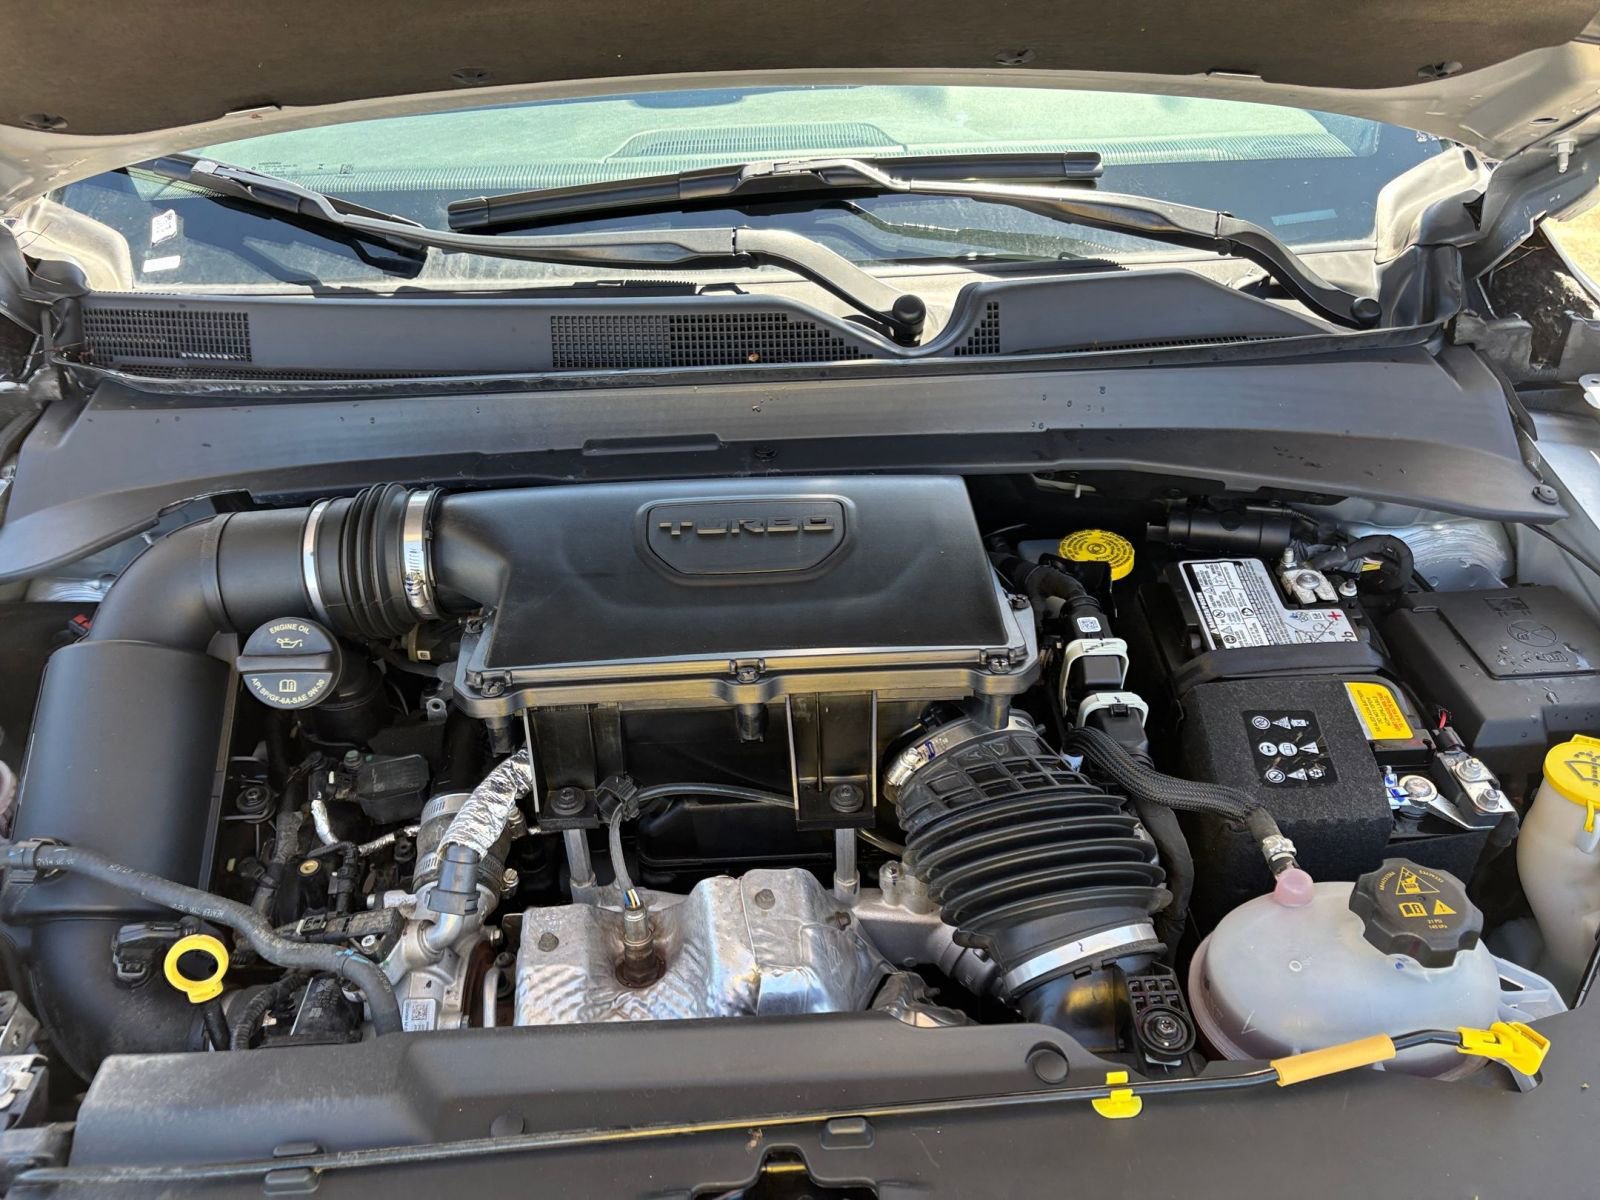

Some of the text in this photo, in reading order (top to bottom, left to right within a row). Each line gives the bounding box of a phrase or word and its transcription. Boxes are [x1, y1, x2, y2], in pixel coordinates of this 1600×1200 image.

[659, 513, 834, 538] TURBO
[269, 624, 310, 635] ENGINE OIL
[251, 678, 262, 690] API
